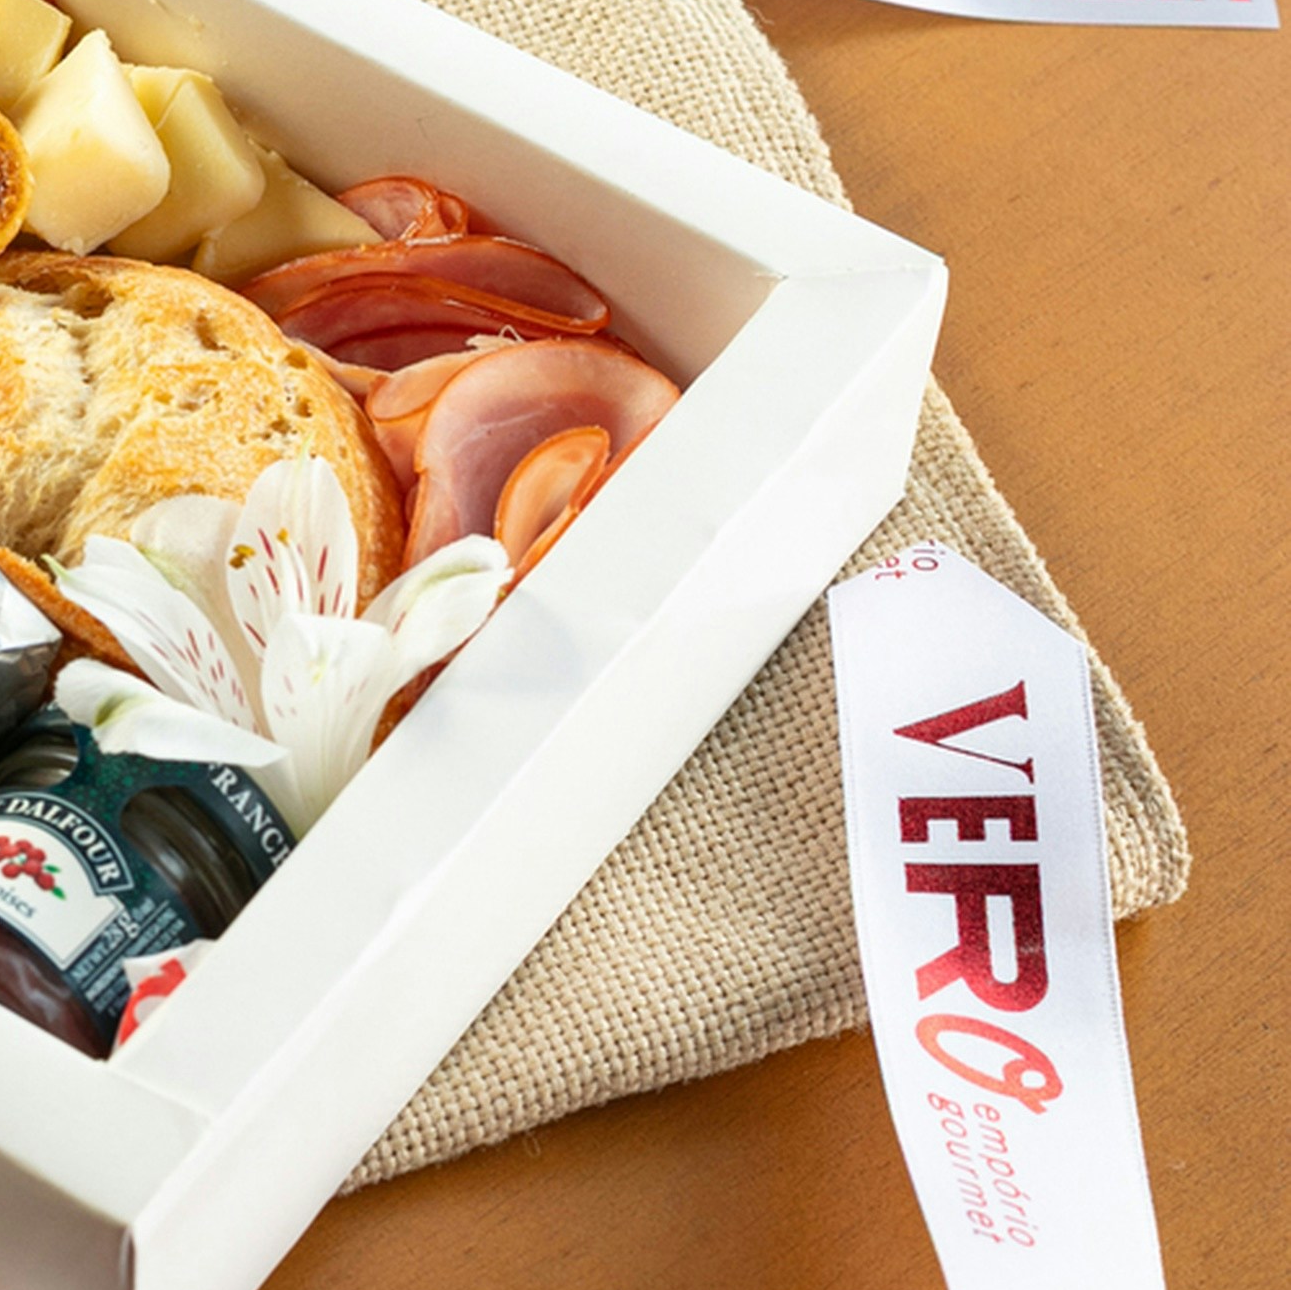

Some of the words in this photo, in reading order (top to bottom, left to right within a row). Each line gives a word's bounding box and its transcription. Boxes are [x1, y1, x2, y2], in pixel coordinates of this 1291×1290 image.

[6, 797, 122, 885] DALFOUR
[891, 679, 1065, 1116] VERO
[927, 1092, 1003, 1246] gourmet
[972, 1101, 1036, 1250] empório
